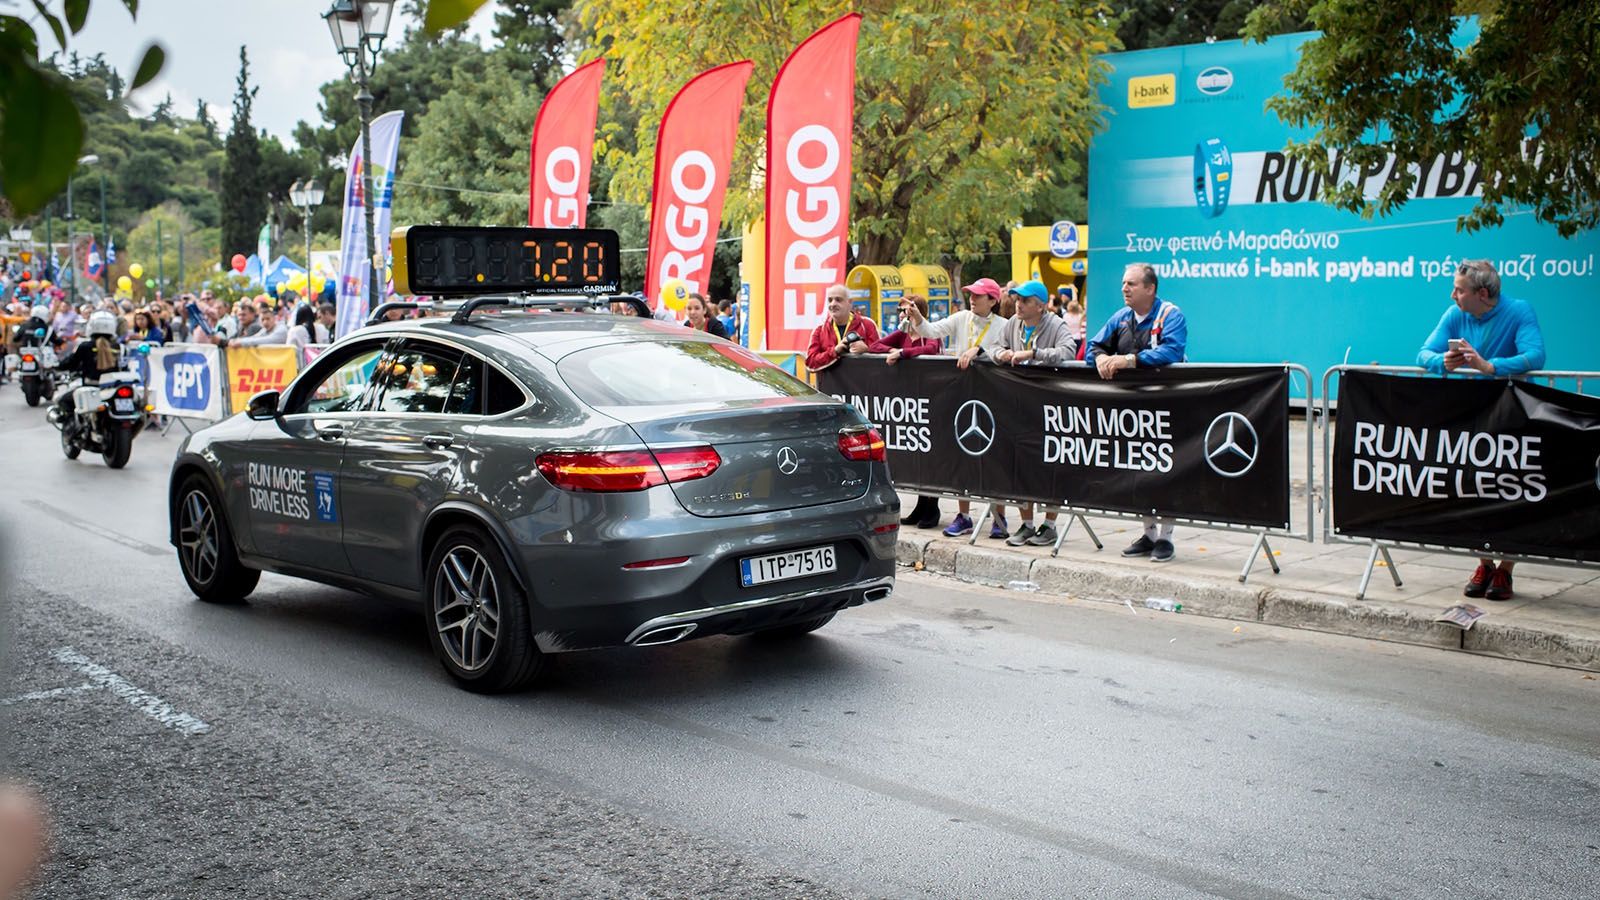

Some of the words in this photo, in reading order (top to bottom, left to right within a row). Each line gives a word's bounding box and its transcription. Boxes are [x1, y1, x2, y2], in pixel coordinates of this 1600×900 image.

[544, 145, 580, 229] GO
[784, 124, 840, 330] ERGO
[1126, 233, 1164, 252] Στον
[1167, 230, 1223, 256] φετινό
[1228, 229, 1339, 254] Μαραθώνιο
[1255, 257, 1320, 277] i-bank
[1326, 255, 1414, 282] payband
[1543, 254, 1593, 276] σου!
[237, 369, 286, 393] DHL
[873, 396, 930, 424] MORE
[1043, 405, 1092, 434] RUN
[1097, 407, 1172, 439] MORE
[886, 424, 932, 453] LESS
[1043, 435, 1109, 467] DRIVE
[1114, 440, 1174, 473] LESS
[1354, 422, 1428, 461] RUN
[1436, 429, 1542, 470] MORE
[248, 462, 271, 487] RUN
[273, 466, 307, 493] MORE
[1353, 459, 1448, 498] DRIVE
[1455, 469, 1547, 502] LESS
[249, 488, 281, 514] DRIVE
[281, 493, 310, 519] LESS
